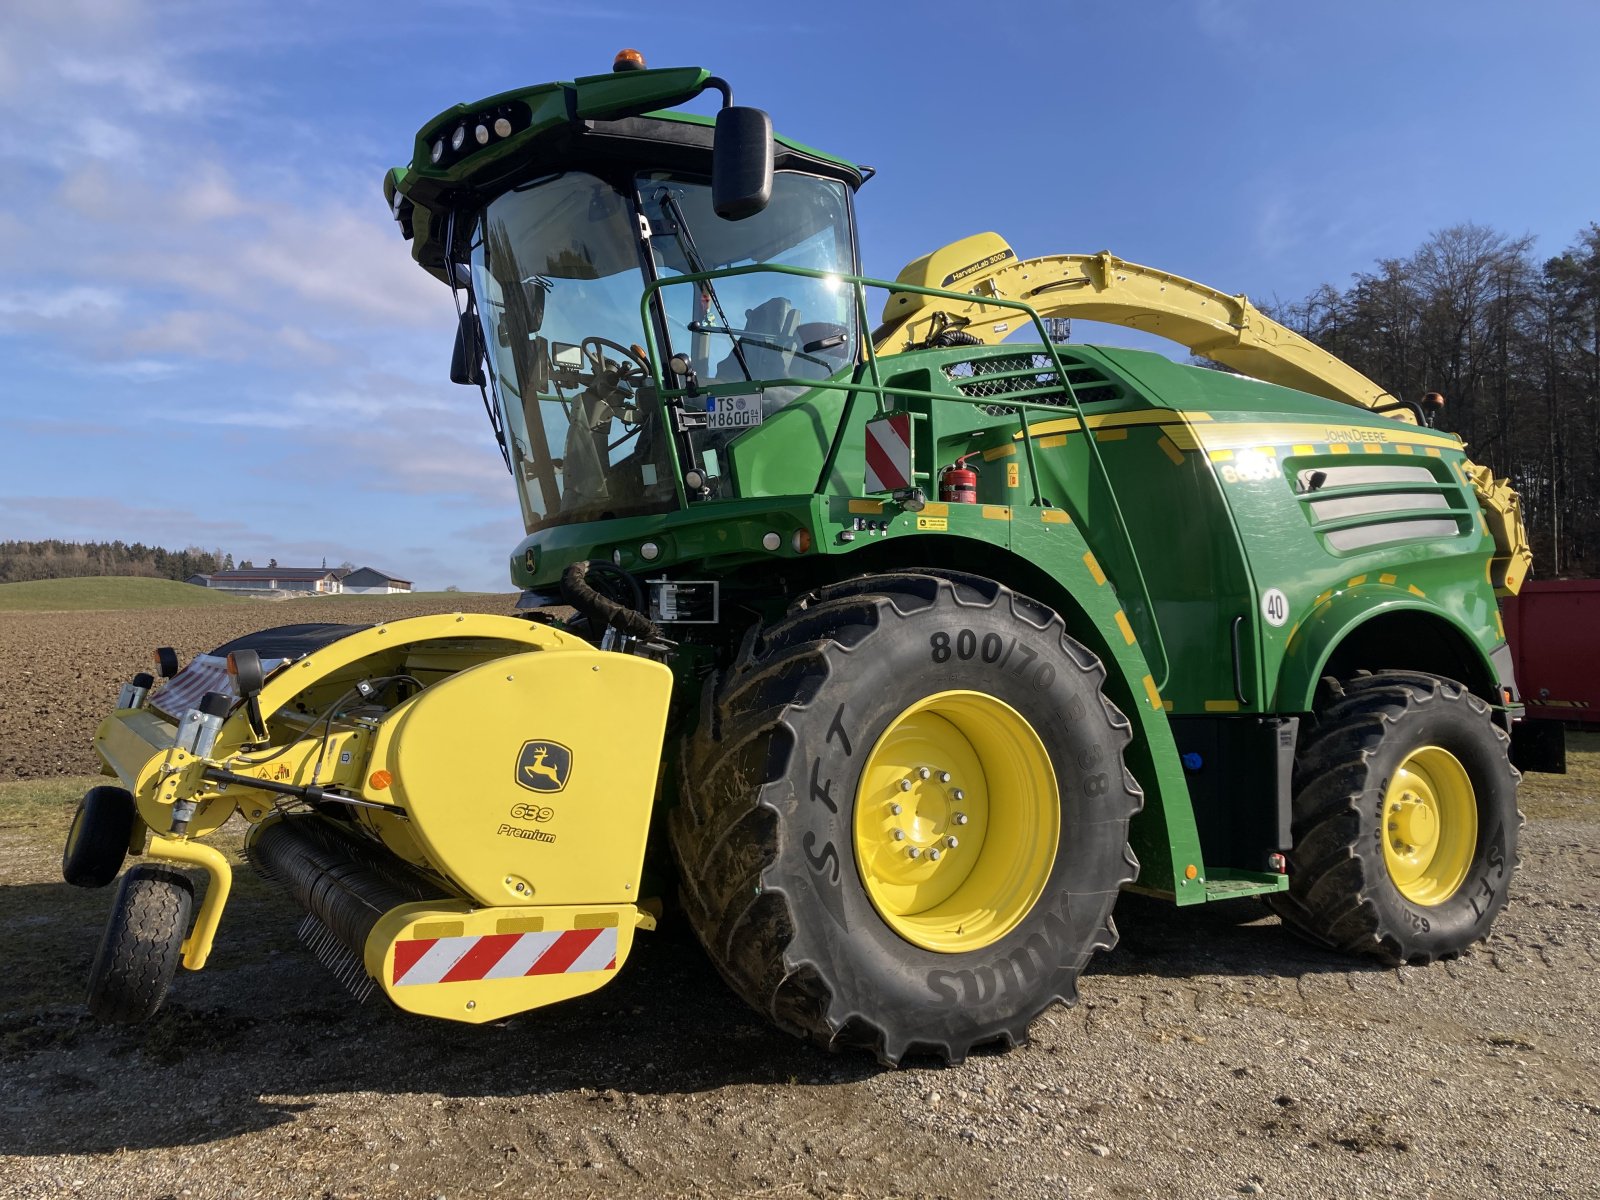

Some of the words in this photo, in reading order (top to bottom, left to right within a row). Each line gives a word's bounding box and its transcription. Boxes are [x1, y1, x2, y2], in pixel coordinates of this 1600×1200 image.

[952, 260, 989, 281] HarvestLab
[990, 253, 1006, 263] 3000
[717, 398, 734, 412] TS
[1268, 595, 1282, 619] 40
[930, 628, 1057, 693] 800/70
[511, 803, 554, 822] 639
[497, 824, 556, 843] Premium
